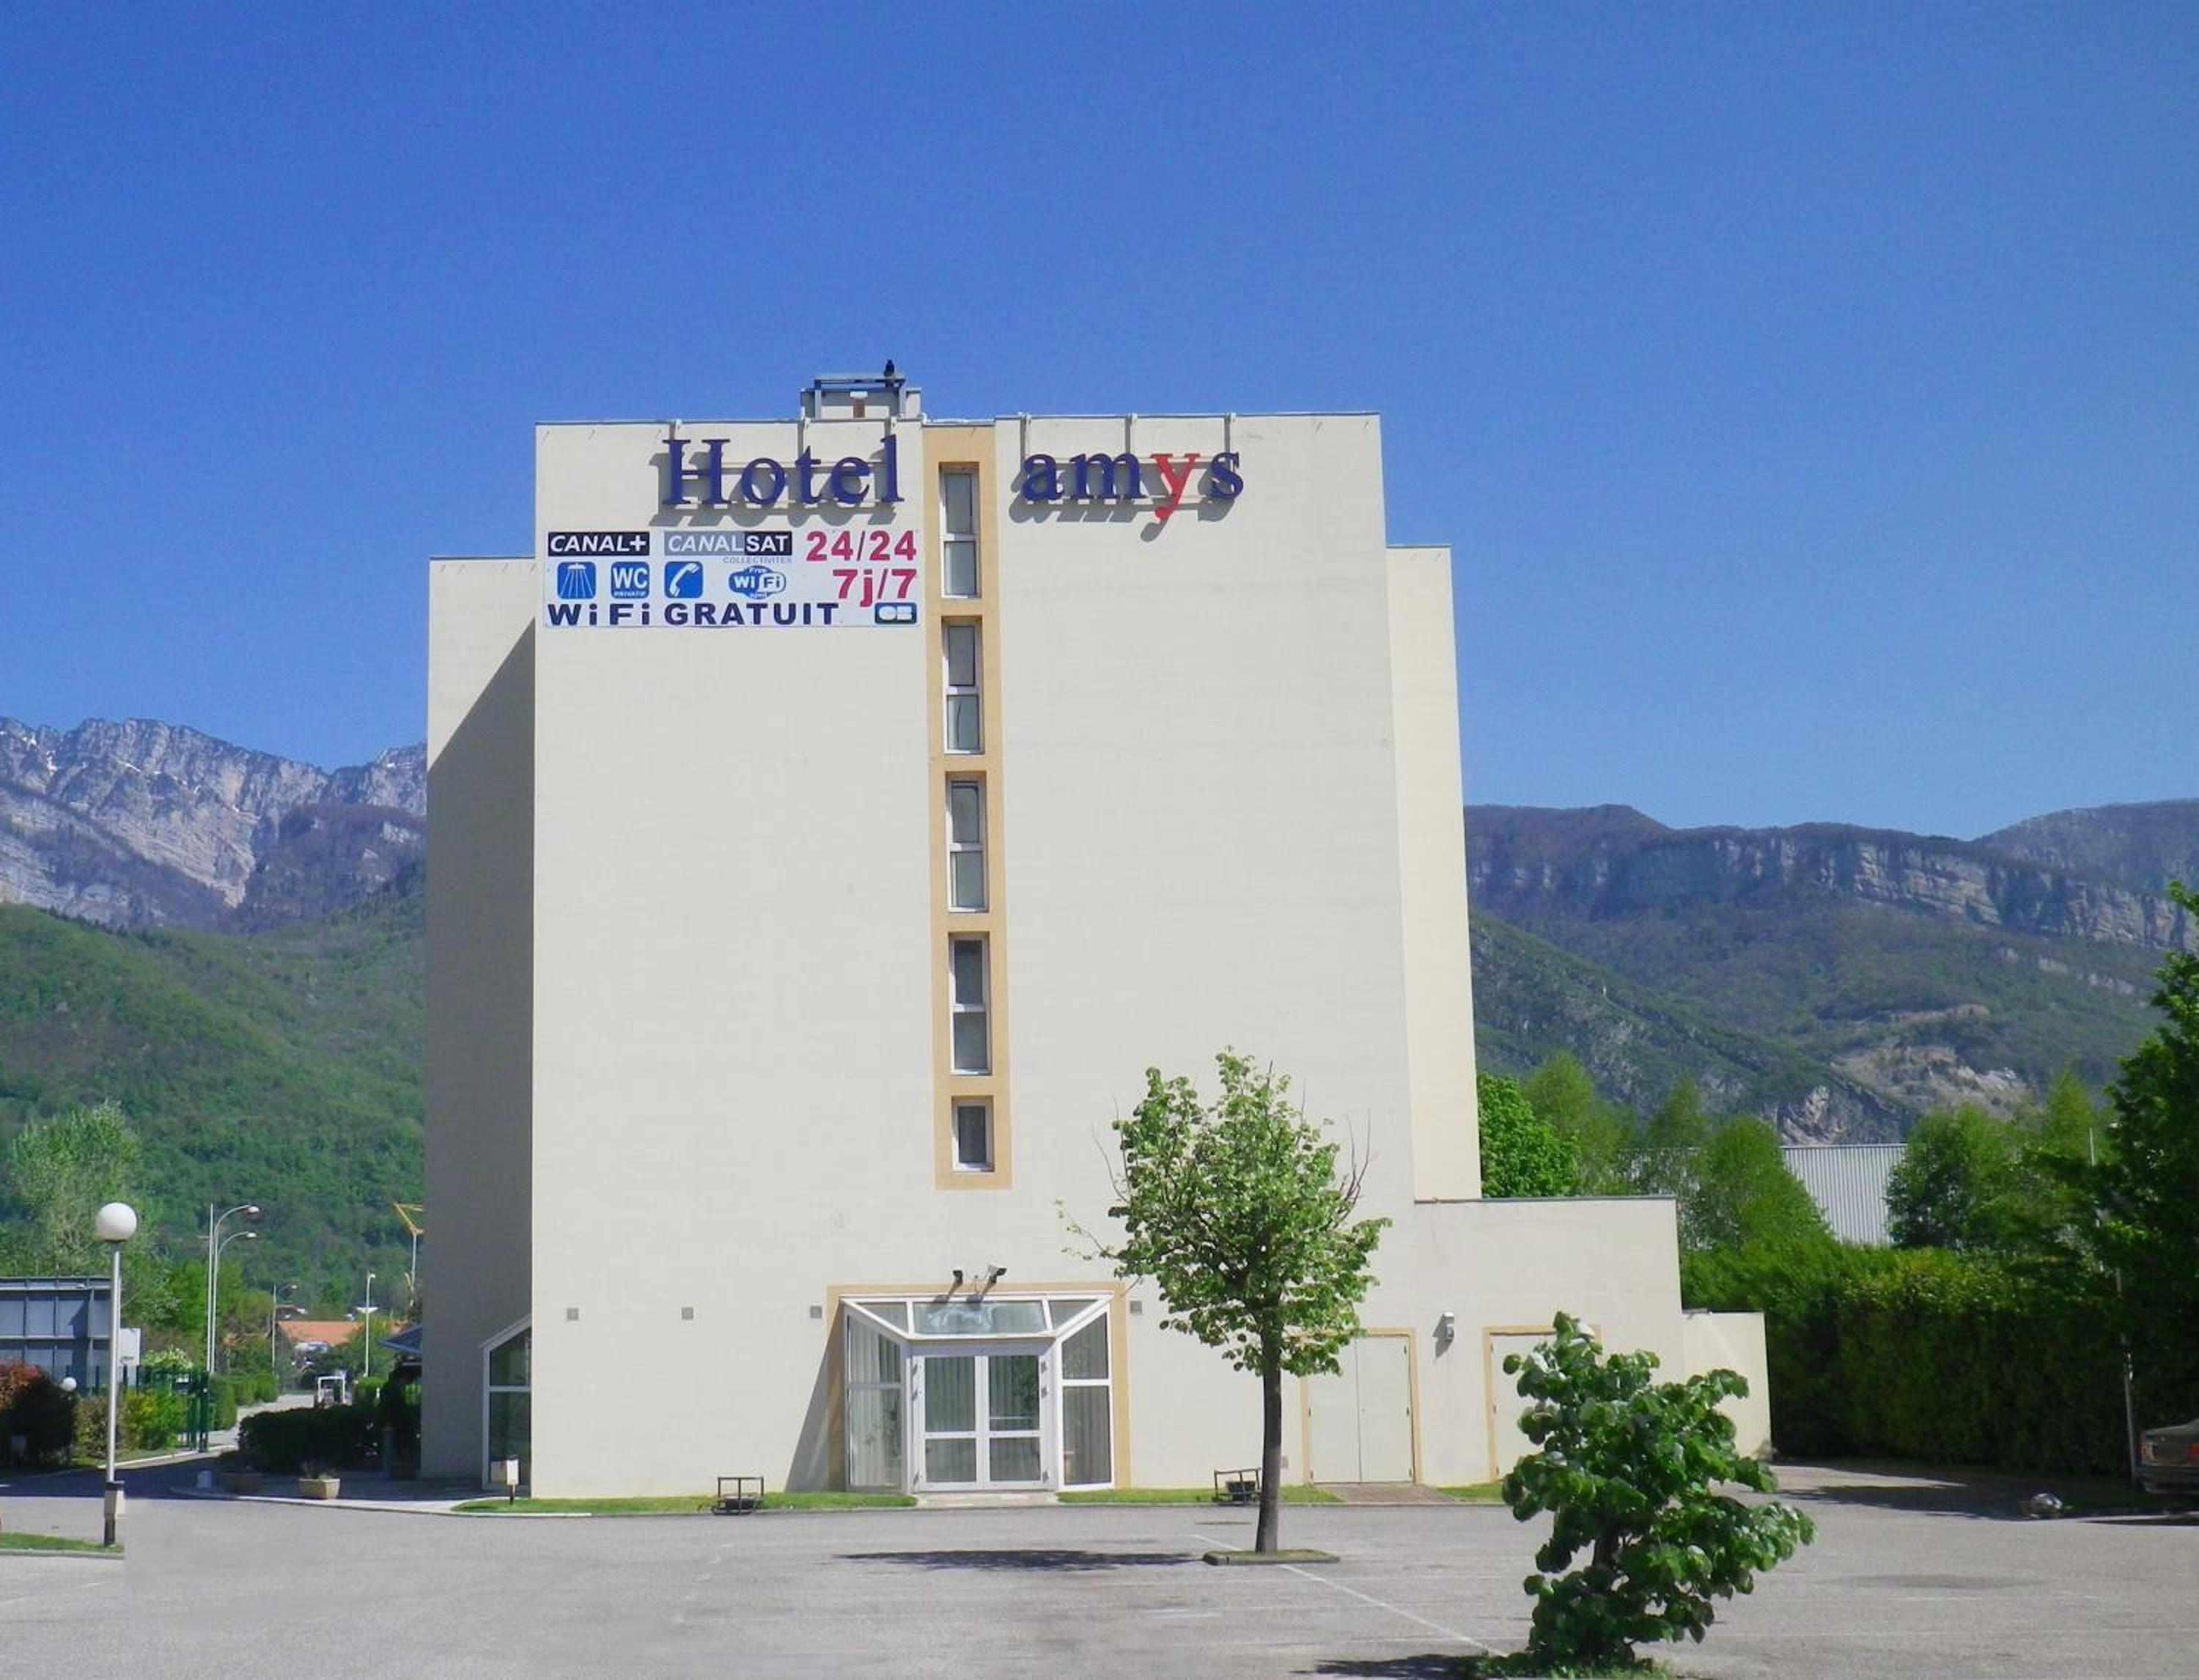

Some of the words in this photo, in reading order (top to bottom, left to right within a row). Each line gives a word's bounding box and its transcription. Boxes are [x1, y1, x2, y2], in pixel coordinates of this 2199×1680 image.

[663, 434, 904, 504] Hotel
[1022, 452, 1243, 523] amys
[550, 535, 646, 552] CANAL+
[806, 531, 916, 561] 24/24
[613, 567, 647, 589] WC
[833, 569, 916, 607] 7j/7
[664, 603, 839, 625] GRATUIT
